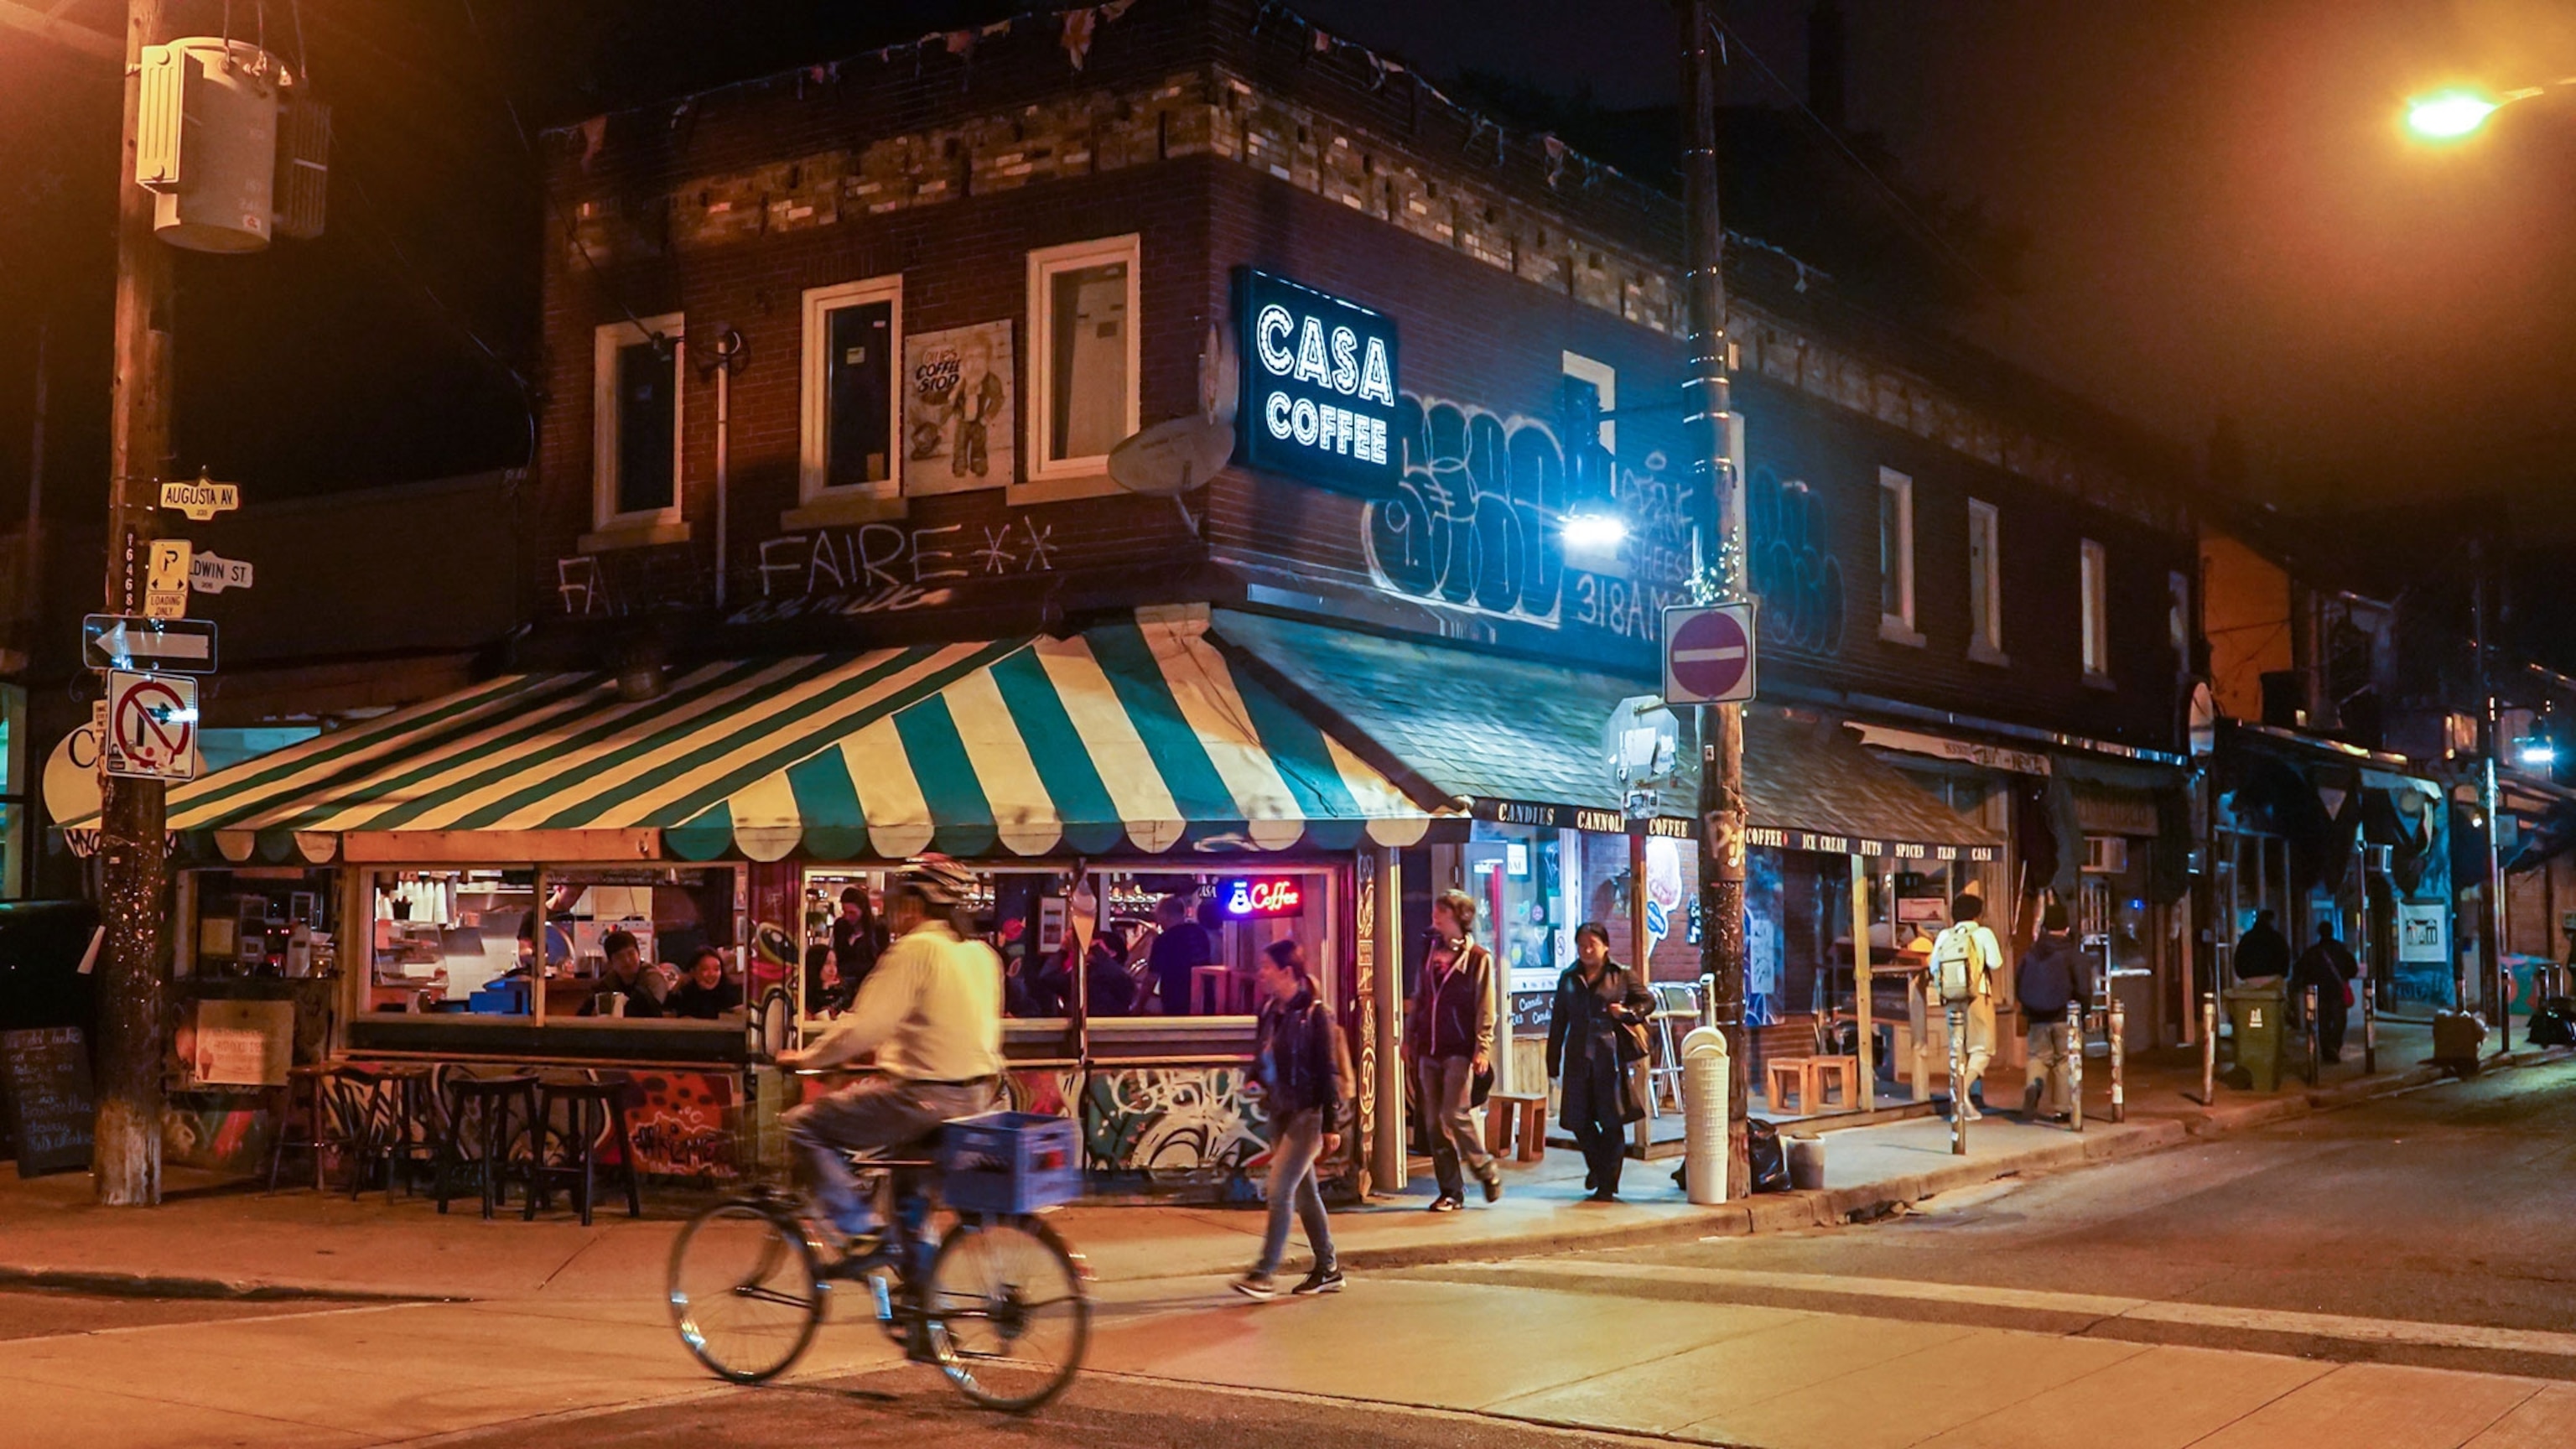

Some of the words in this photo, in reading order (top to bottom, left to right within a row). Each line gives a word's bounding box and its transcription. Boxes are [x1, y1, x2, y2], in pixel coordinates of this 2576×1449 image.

[1257, 304, 1394, 408] CASA
[918, 374, 959, 392] STOP
[1266, 391, 1387, 465] COFFEE
[164, 488, 216, 505] AUGUSTA
[190, 559, 225, 579] DWIN
[231, 567, 247, 583] ST
[1498, 802, 1554, 826] CANDIES
[1577, 810, 1625, 832] CANNOLI
[1649, 818, 1688, 838] COFFEE
[1745, 828, 1782, 847] COFFEE
[1803, 834, 1817, 850] ICE
[1820, 835, 1847, 853] CREAM
[1861, 839, 1883, 856] NUTS
[1896, 844, 1924, 859] SPICES
[1938, 846, 1956, 860] TEAS
[1972, 847, 1992, 861] CASA
[1250, 880, 1298, 911] Coffee
